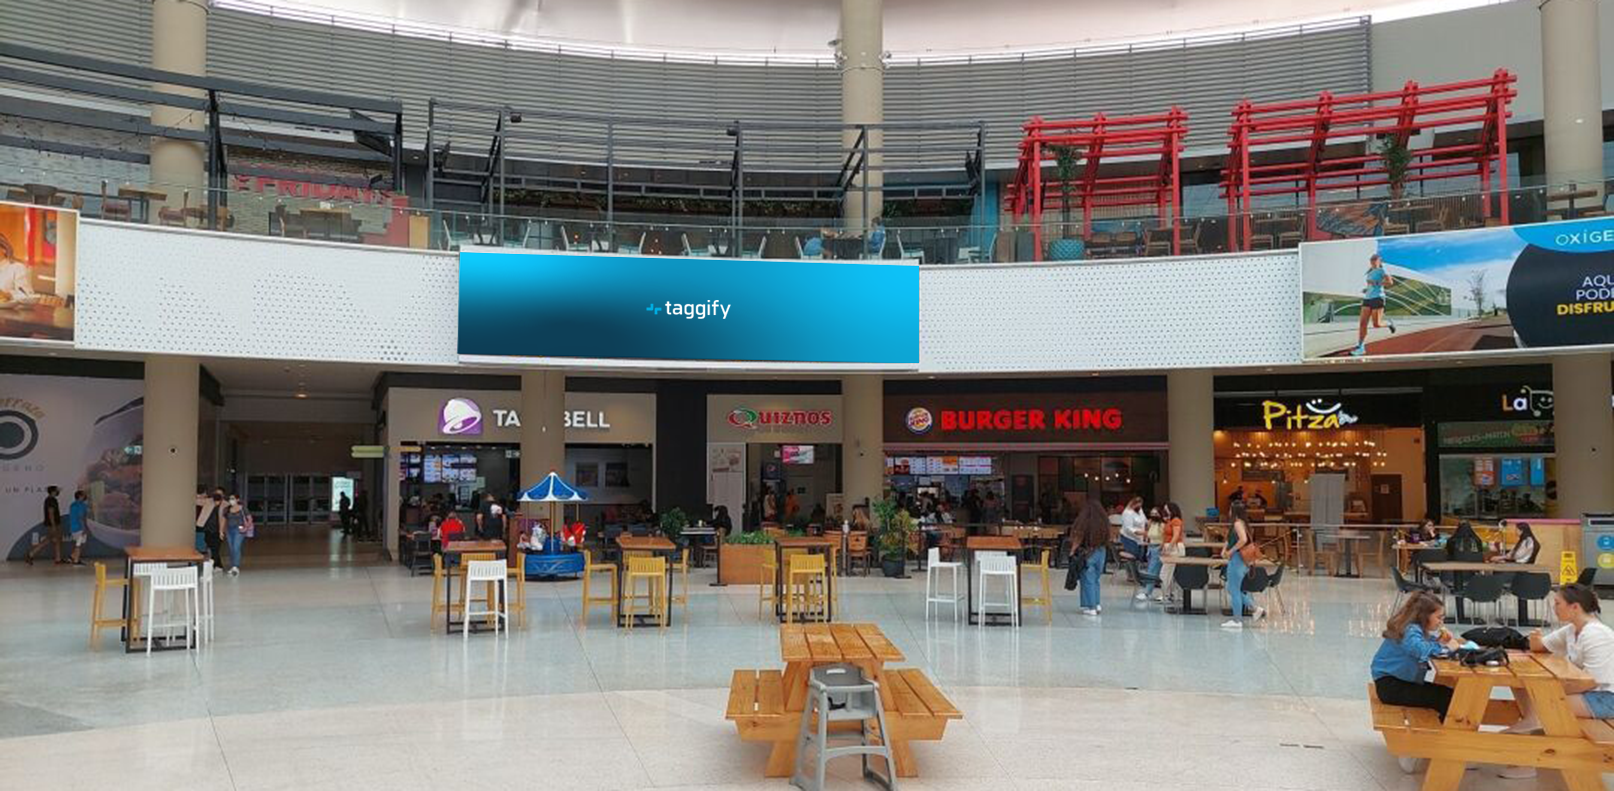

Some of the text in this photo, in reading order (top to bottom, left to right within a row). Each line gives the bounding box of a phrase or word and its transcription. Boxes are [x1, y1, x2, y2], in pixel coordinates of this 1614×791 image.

[665, 300, 731, 319] taggify
[1556, 301, 1614, 315] DISFRU
[1501, 393, 1528, 411] La
[941, 408, 1124, 430] BURGER KING
[1262, 400, 1340, 430] Pitza
